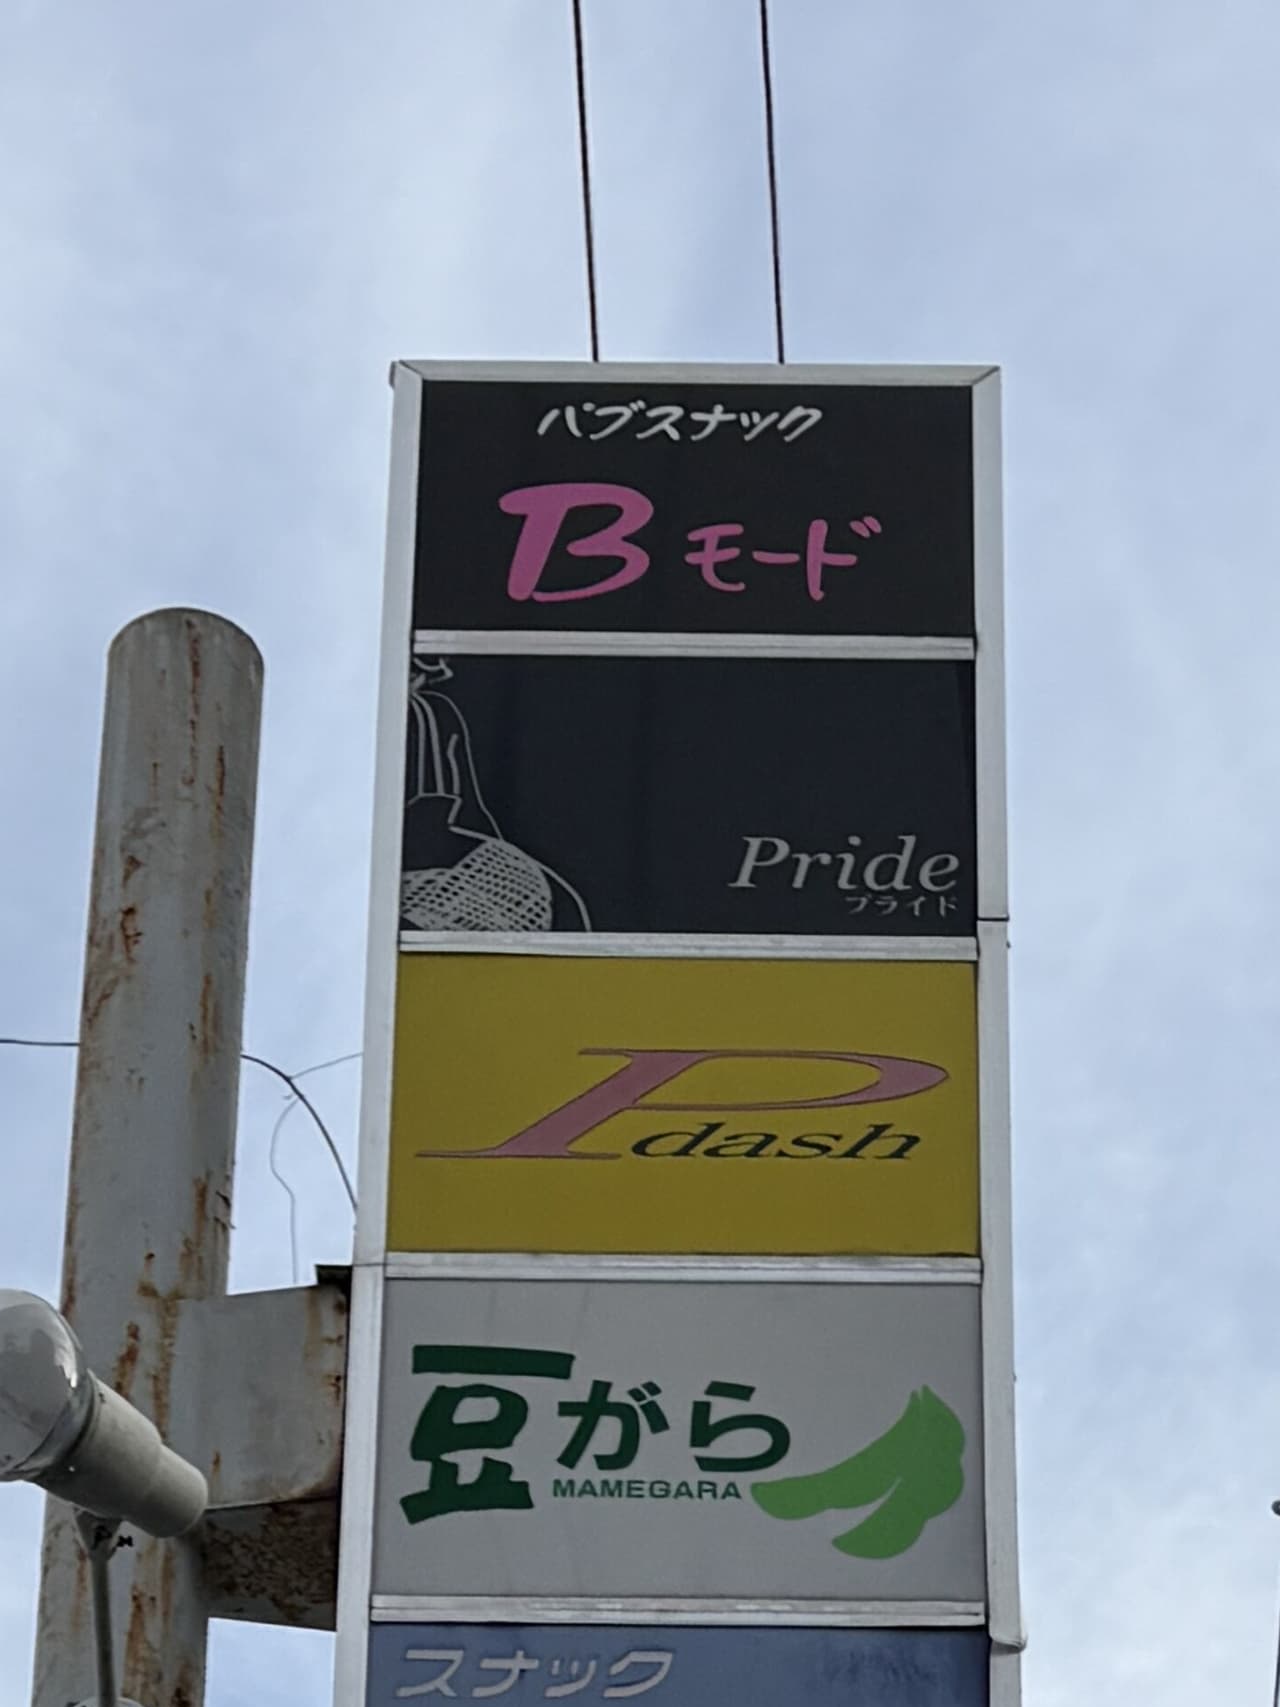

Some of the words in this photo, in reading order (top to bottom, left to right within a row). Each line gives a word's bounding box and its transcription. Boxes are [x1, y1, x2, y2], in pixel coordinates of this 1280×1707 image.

[537, 400, 823, 442] パブスナック
[728, 835, 960, 892] Pride
[630, 1122, 921, 1160] dash
[400, 1345, 790, 1525] 豆がら
[552, 1478, 742, 1501] MAMEGARA
[395, 1649, 674, 1699] スナック
